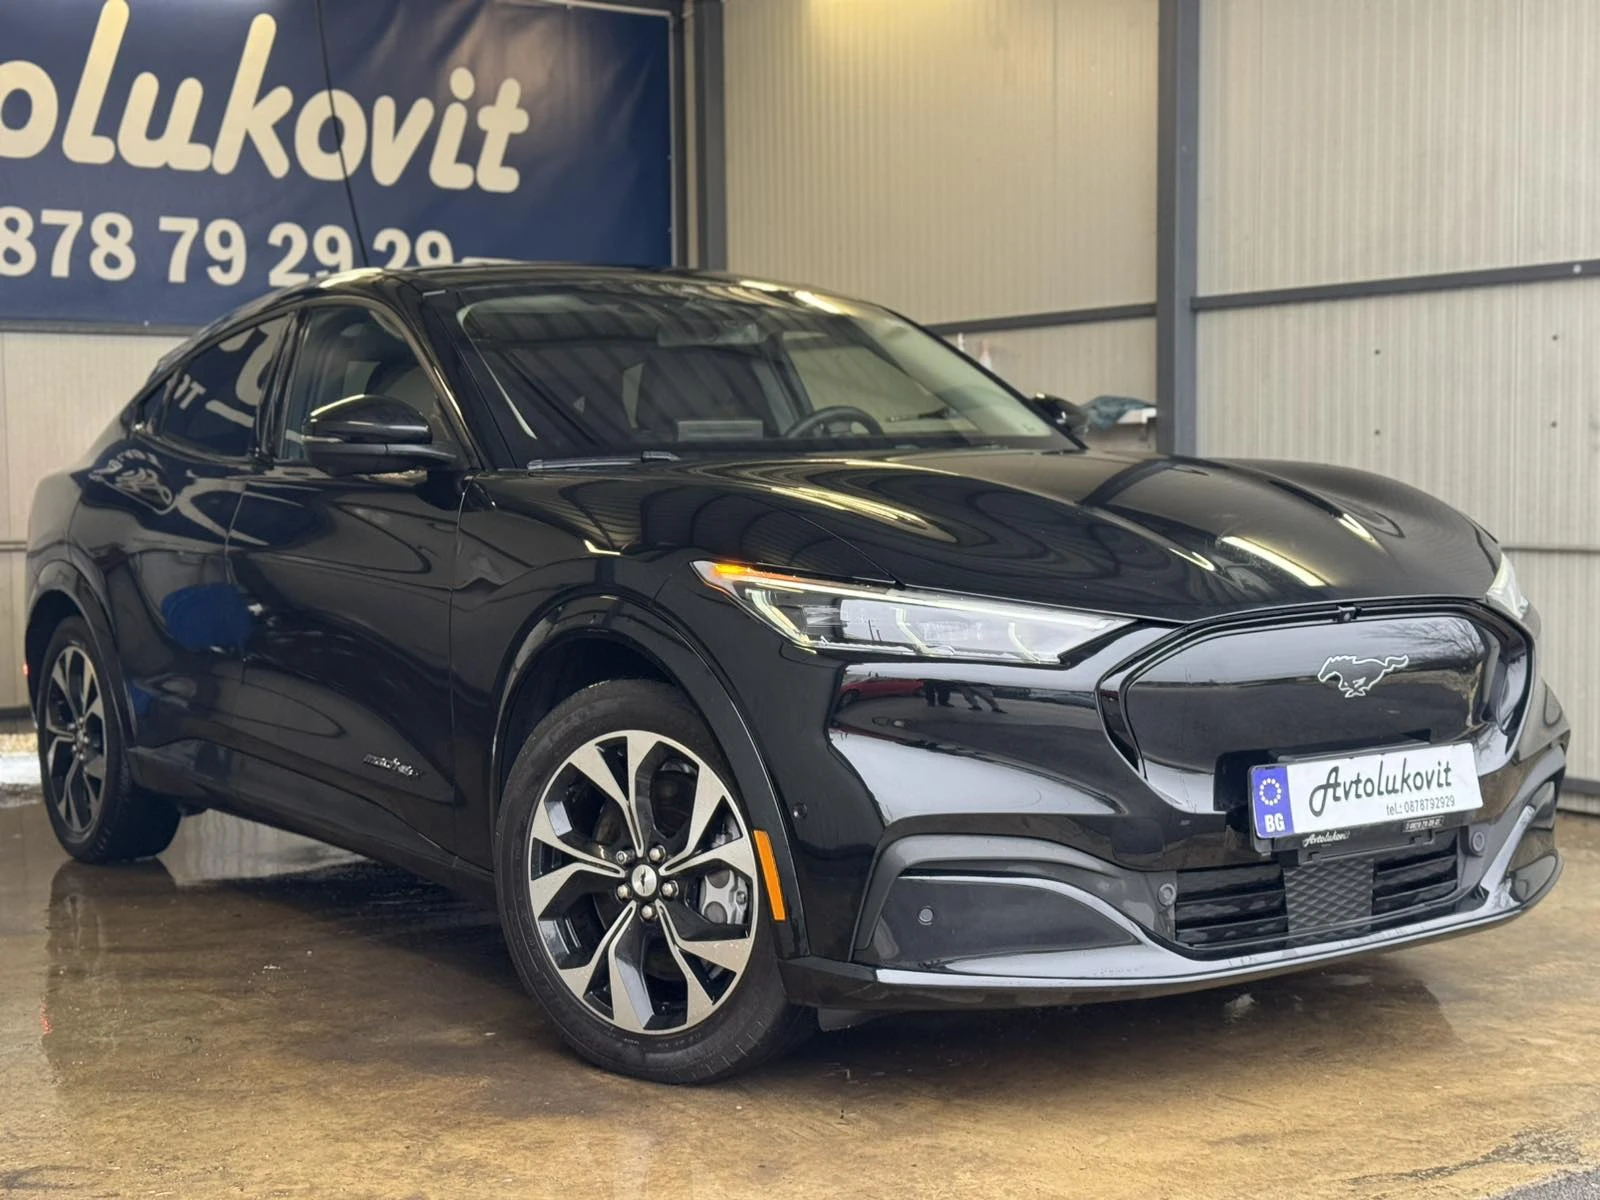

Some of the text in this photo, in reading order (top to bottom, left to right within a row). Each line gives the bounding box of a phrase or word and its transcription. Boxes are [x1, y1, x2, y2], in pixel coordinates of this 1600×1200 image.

[0, 206, 136, 281] 878
[158, 216, 247, 286] 79
[267, 222, 354, 287] 29
[1309, 758, 1452, 816] Avtolukovit
[1404, 795, 1455, 813] 0878792929
[1264, 813, 1285, 833] BG
